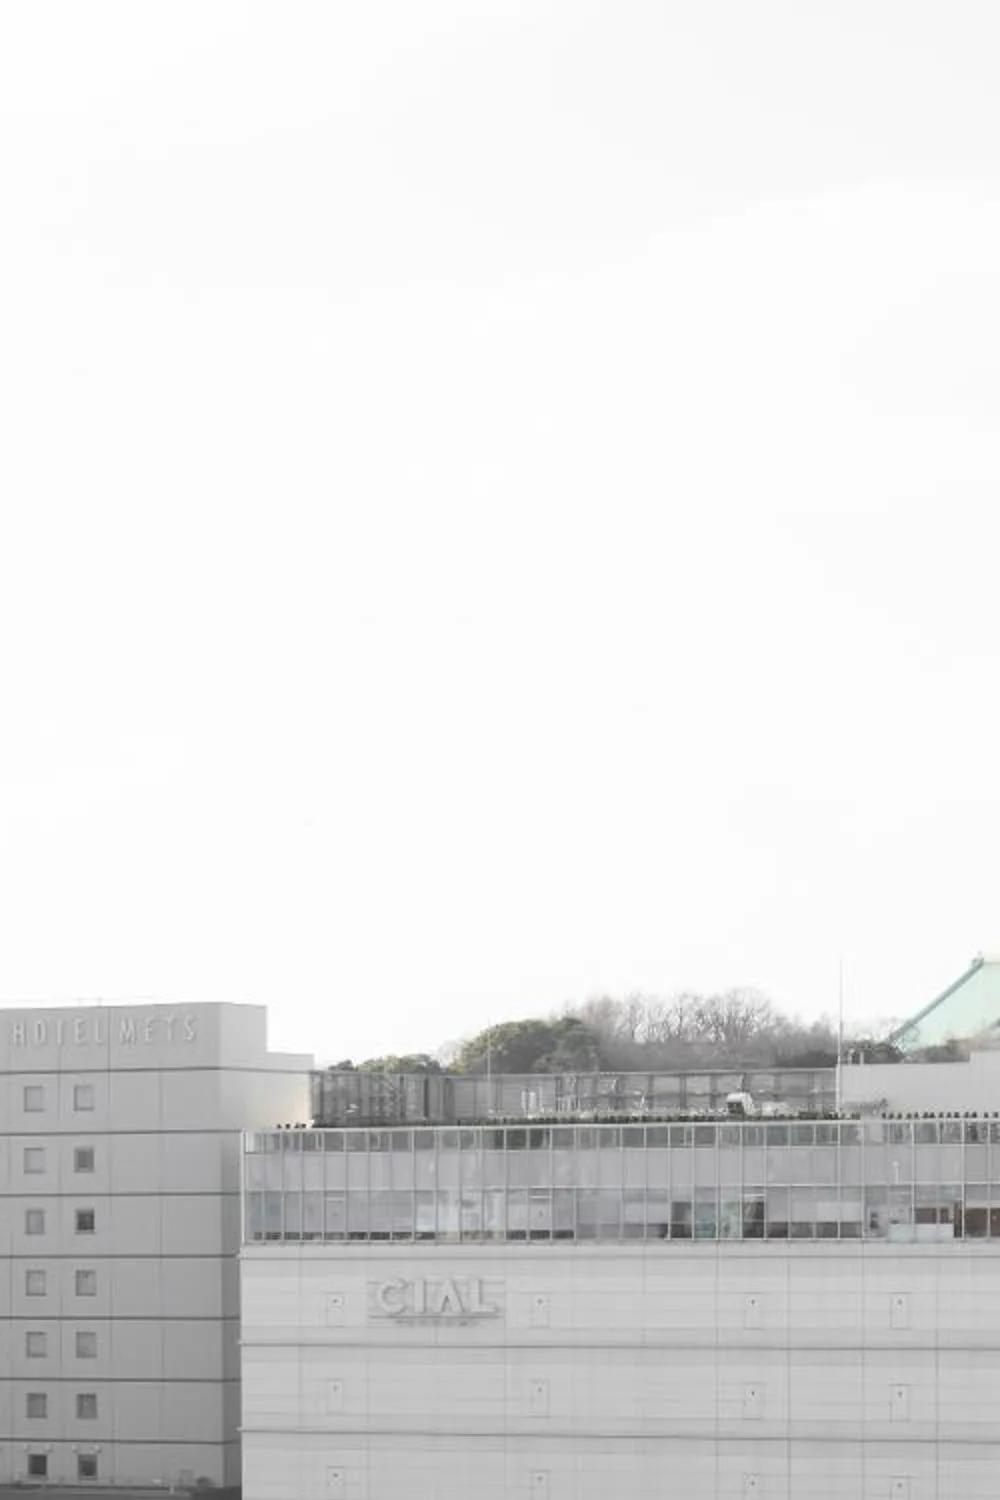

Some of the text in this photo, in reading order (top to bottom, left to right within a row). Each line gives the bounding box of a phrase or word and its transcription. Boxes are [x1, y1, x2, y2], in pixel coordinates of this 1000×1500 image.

[12, 1011, 199, 1048] HOTEL METS
[377, 1278, 500, 1314] CIAL
